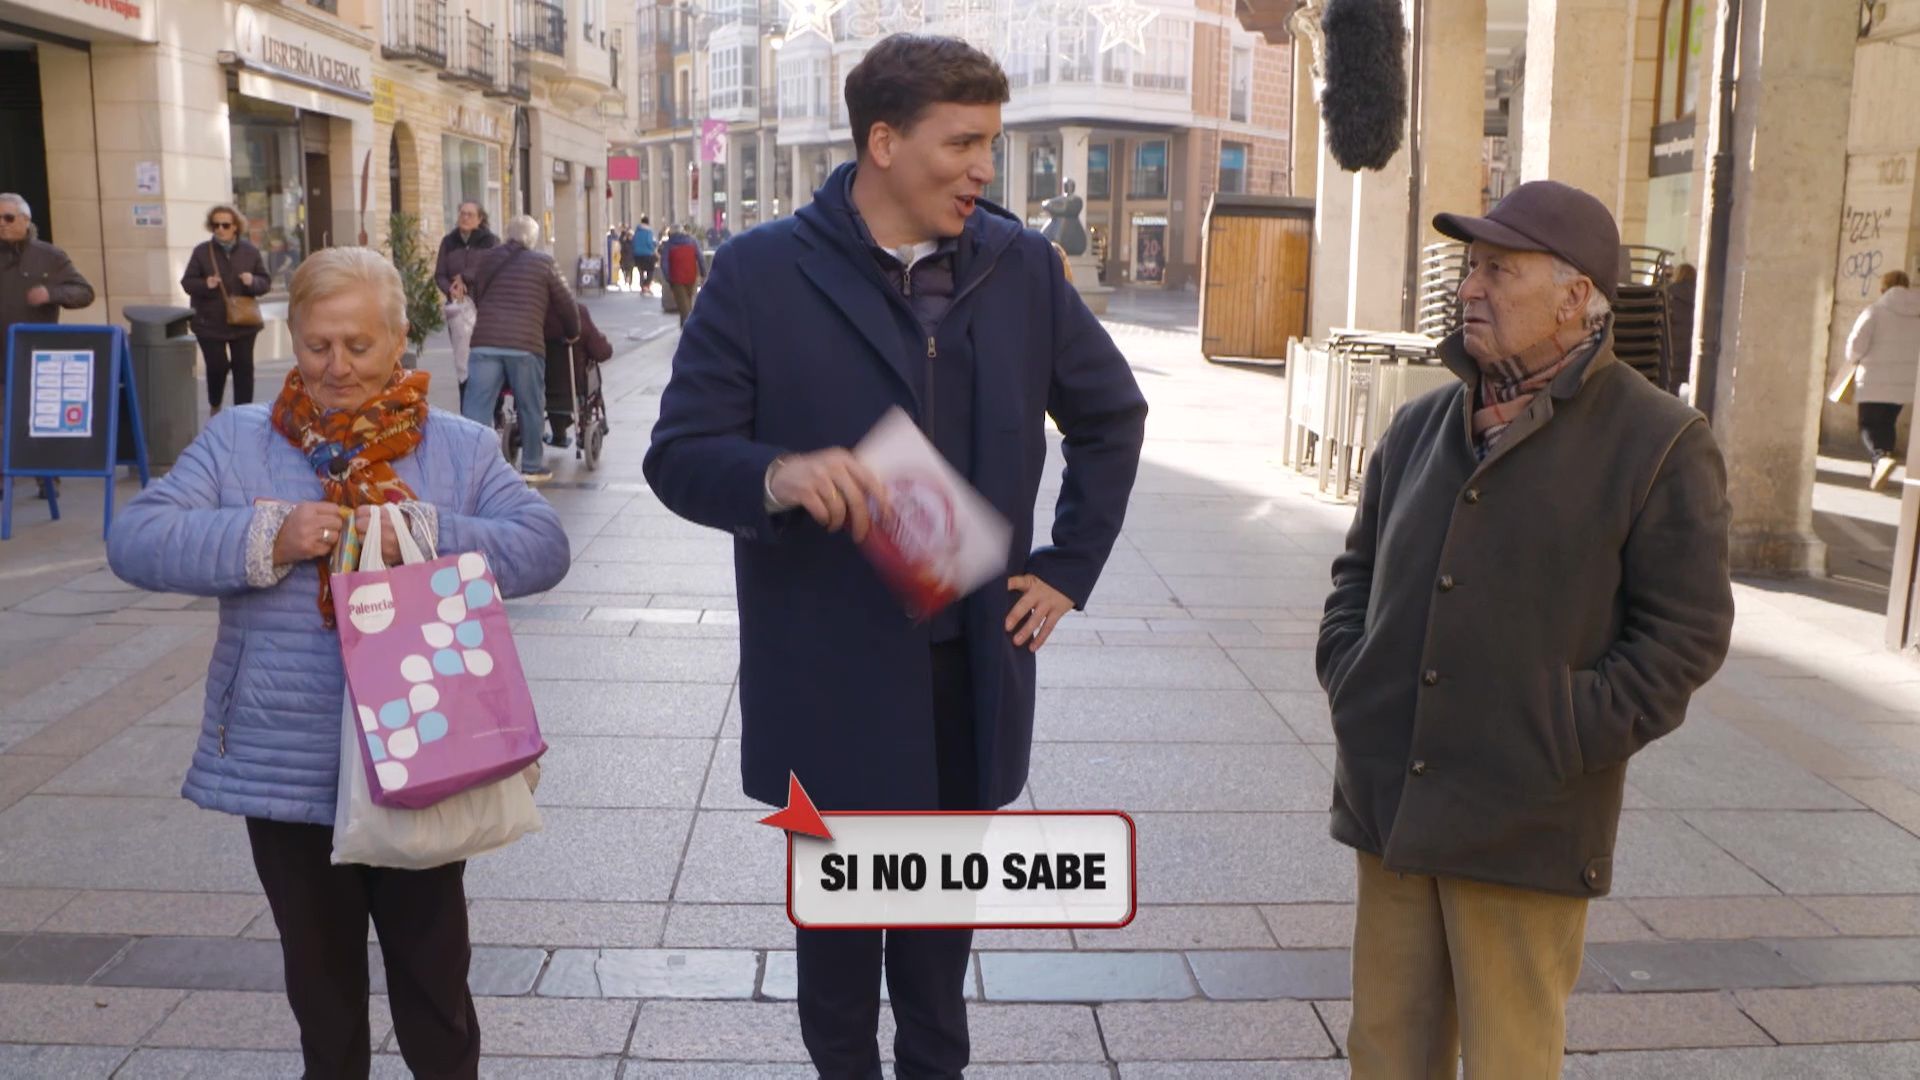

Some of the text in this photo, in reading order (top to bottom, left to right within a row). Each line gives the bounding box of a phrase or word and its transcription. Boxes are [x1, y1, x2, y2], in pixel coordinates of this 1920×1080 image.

[262, 34, 362, 90] LIBRERÍA IGLESIAS
[349, 599, 393, 615] Palencia
